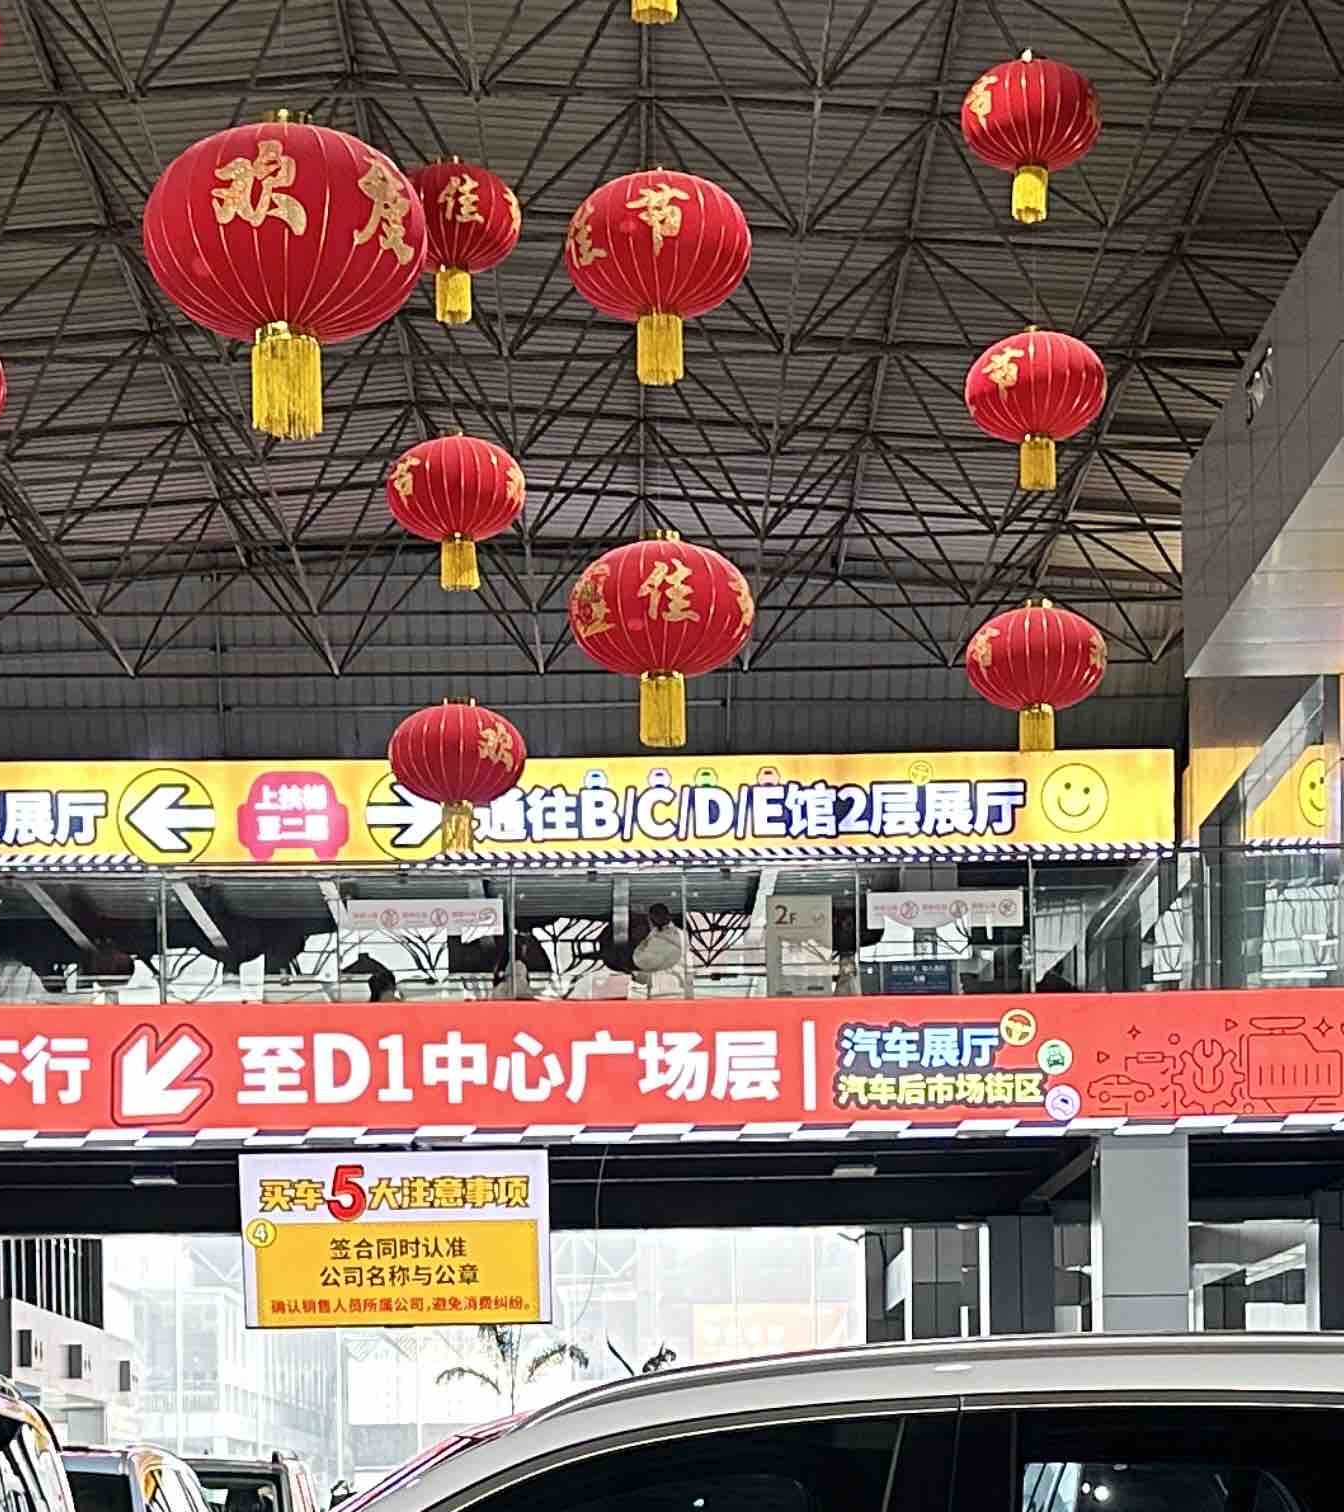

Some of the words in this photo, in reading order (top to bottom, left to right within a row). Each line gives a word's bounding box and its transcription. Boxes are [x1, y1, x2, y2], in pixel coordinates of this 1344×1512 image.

[774, 904, 798, 926] 2F
[840, 1026, 1000, 1069] 汽车展厅
[236, 1028, 781, 1105] 至D1中心广场层
[838, 1072, 1044, 1106] 汽车后市场街区
[258, 1164, 530, 1222] 买车5大注意事项
[329, 1236, 468, 1260] 签合同时认准
[319, 1263, 480, 1288] 公司名称与公章
